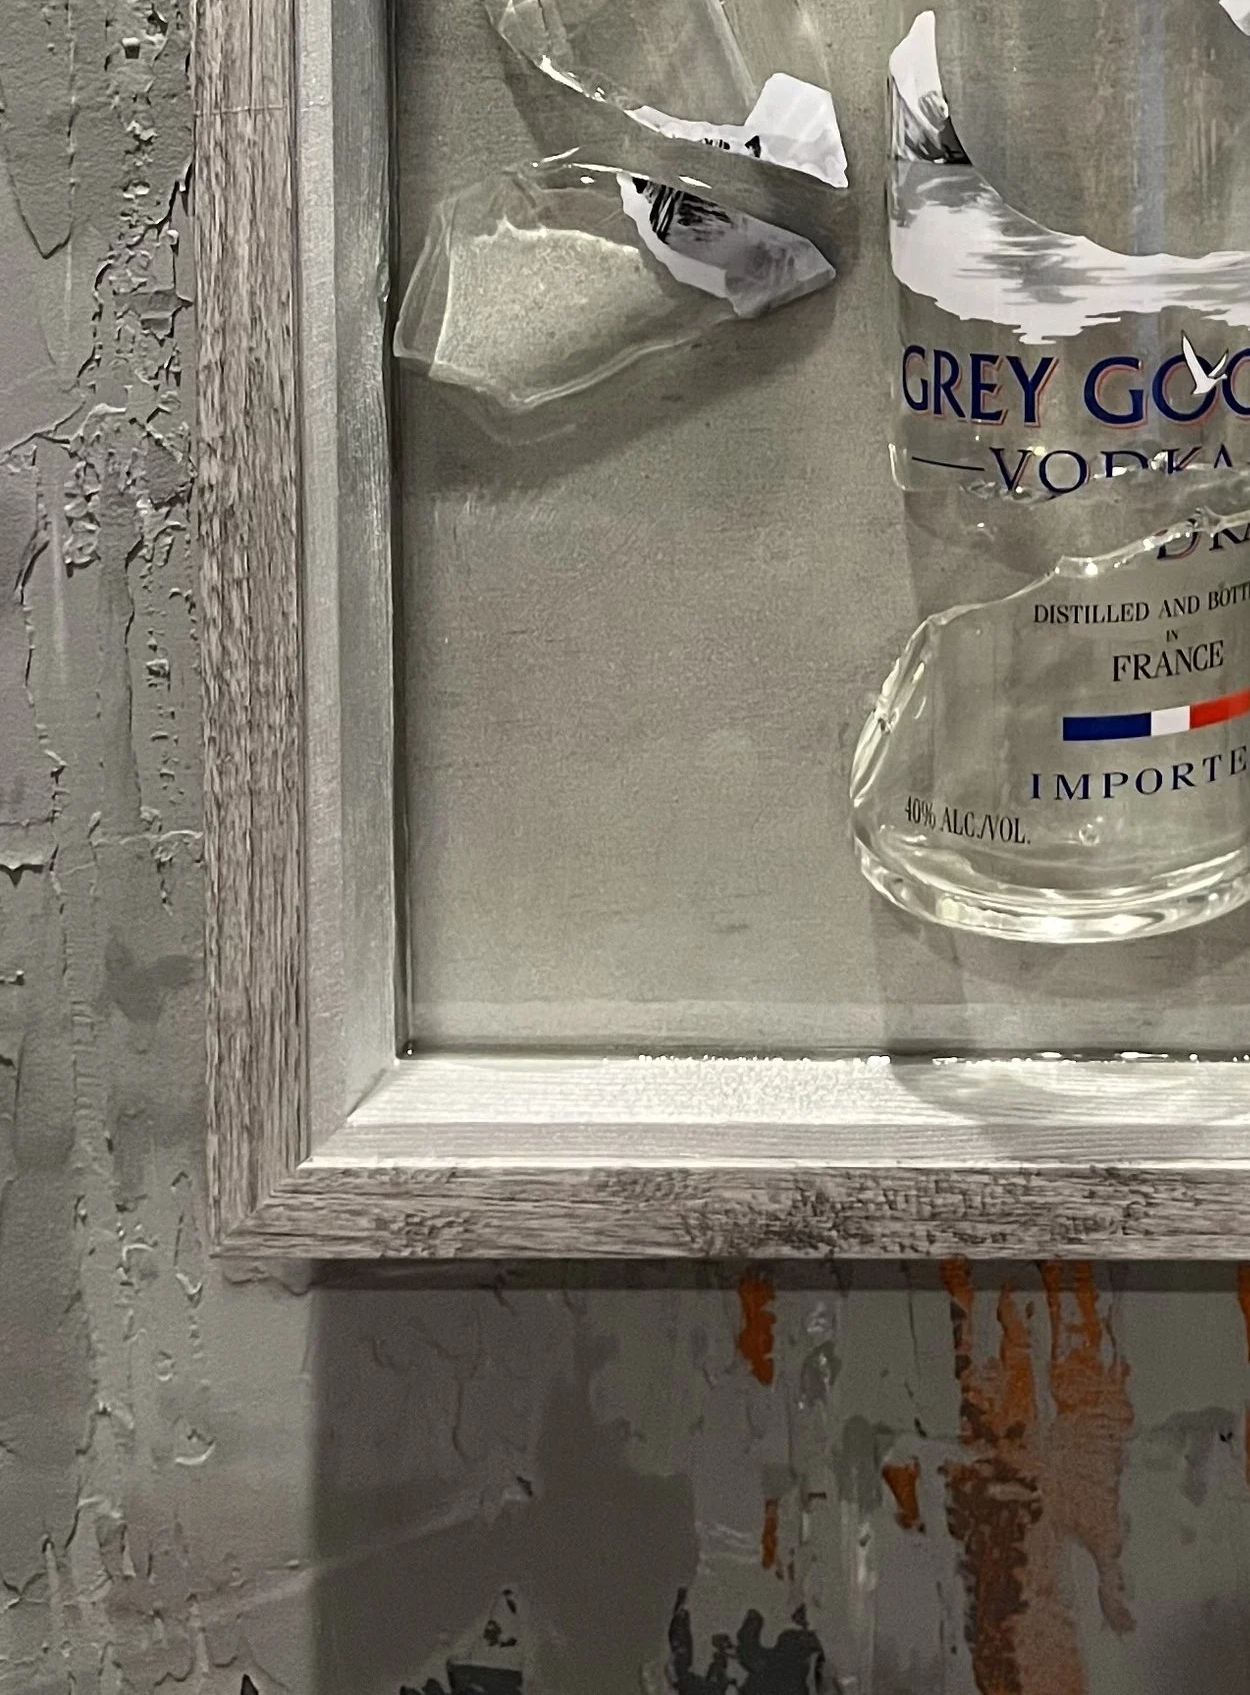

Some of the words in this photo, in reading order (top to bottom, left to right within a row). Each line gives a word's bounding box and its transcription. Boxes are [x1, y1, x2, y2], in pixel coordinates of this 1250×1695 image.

[902, 345, 1059, 427] GREY
[1033, 602, 1150, 624] DISTILLED
[1158, 594, 1201, 619] AND
[1166, 629, 1179, 643] IN
[1112, 640, 1225, 682] FRANCE
[904, 796, 936, 830] 40%
